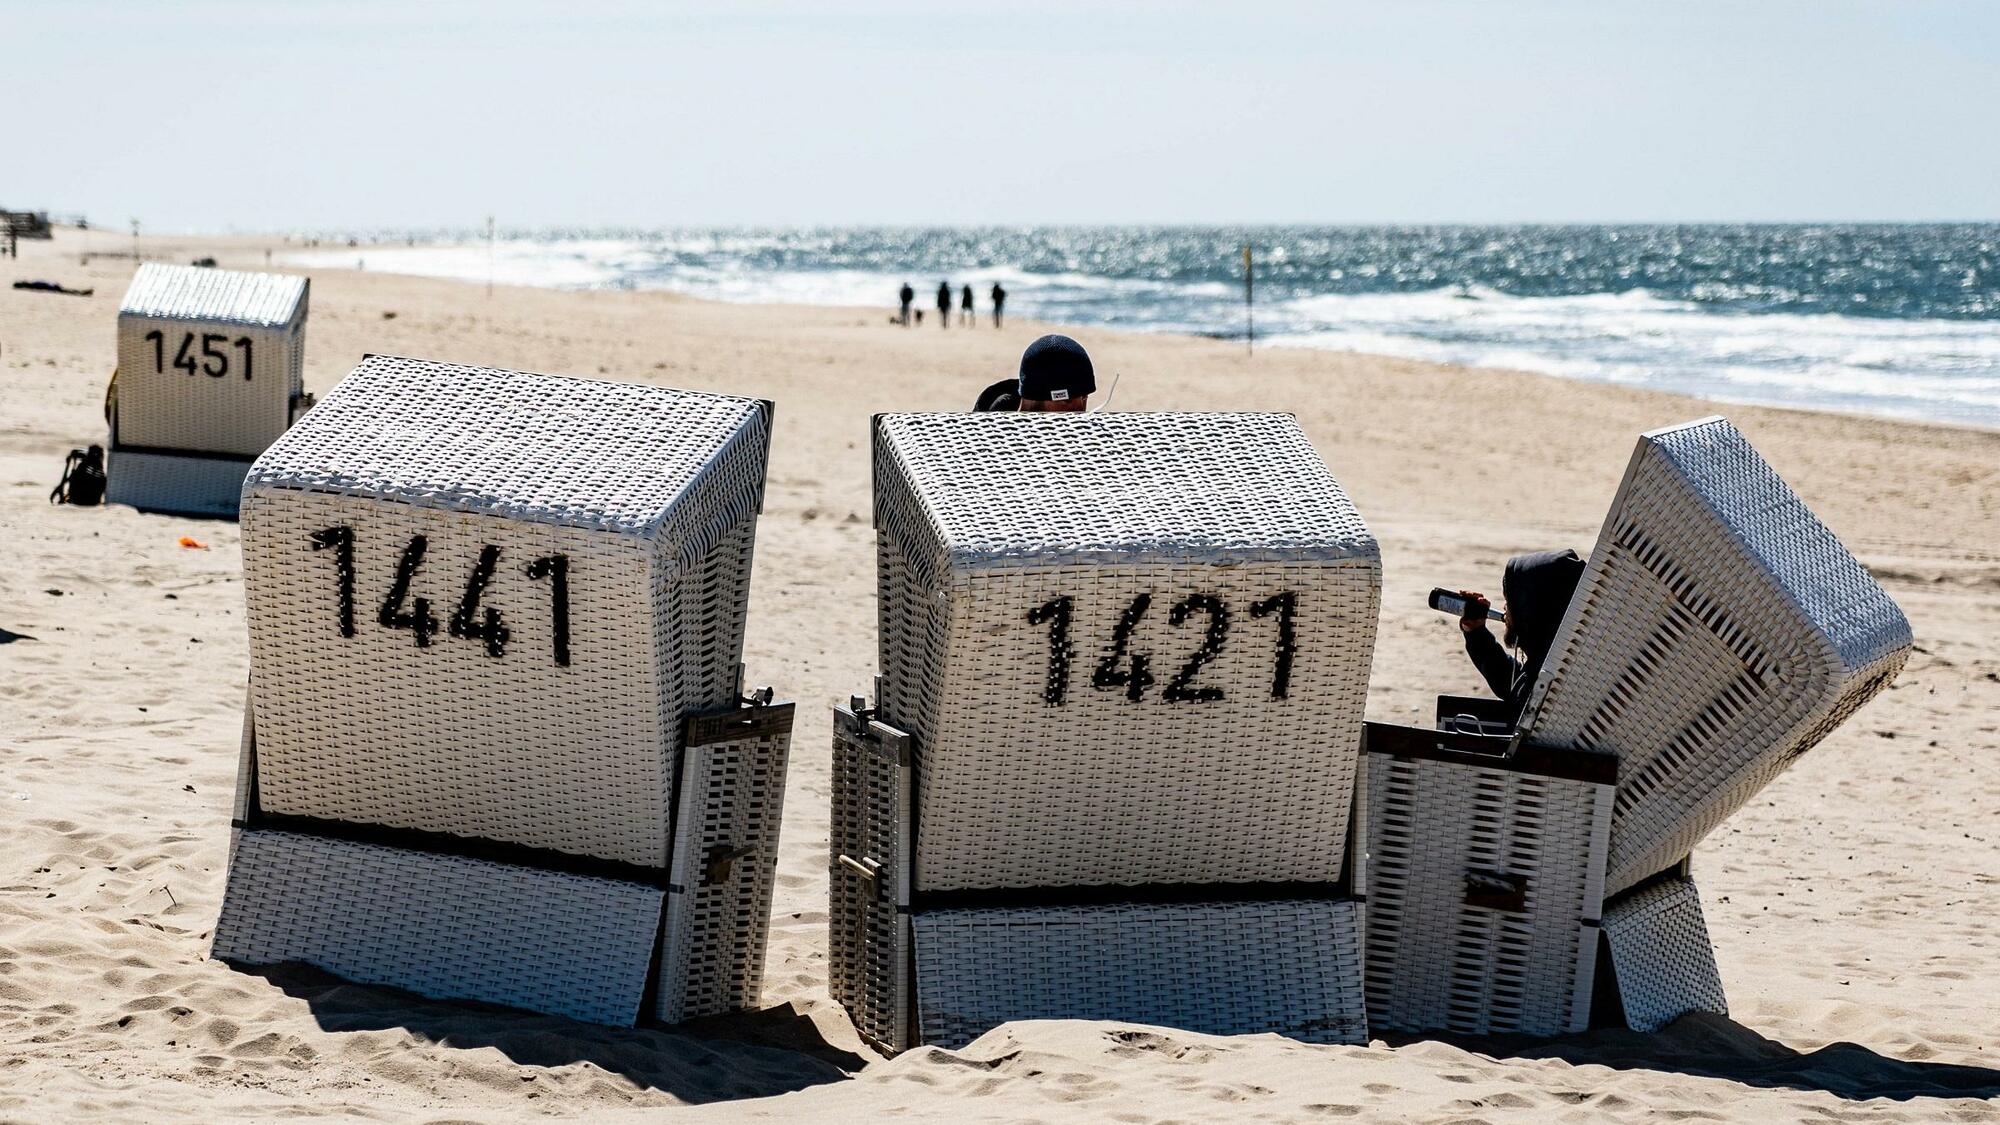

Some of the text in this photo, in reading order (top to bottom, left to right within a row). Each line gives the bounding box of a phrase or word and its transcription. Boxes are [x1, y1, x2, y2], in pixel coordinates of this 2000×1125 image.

[145, 330, 253, 381] 1451
[310, 525, 570, 667] 1441
[1027, 592, 1298, 706] 1421
